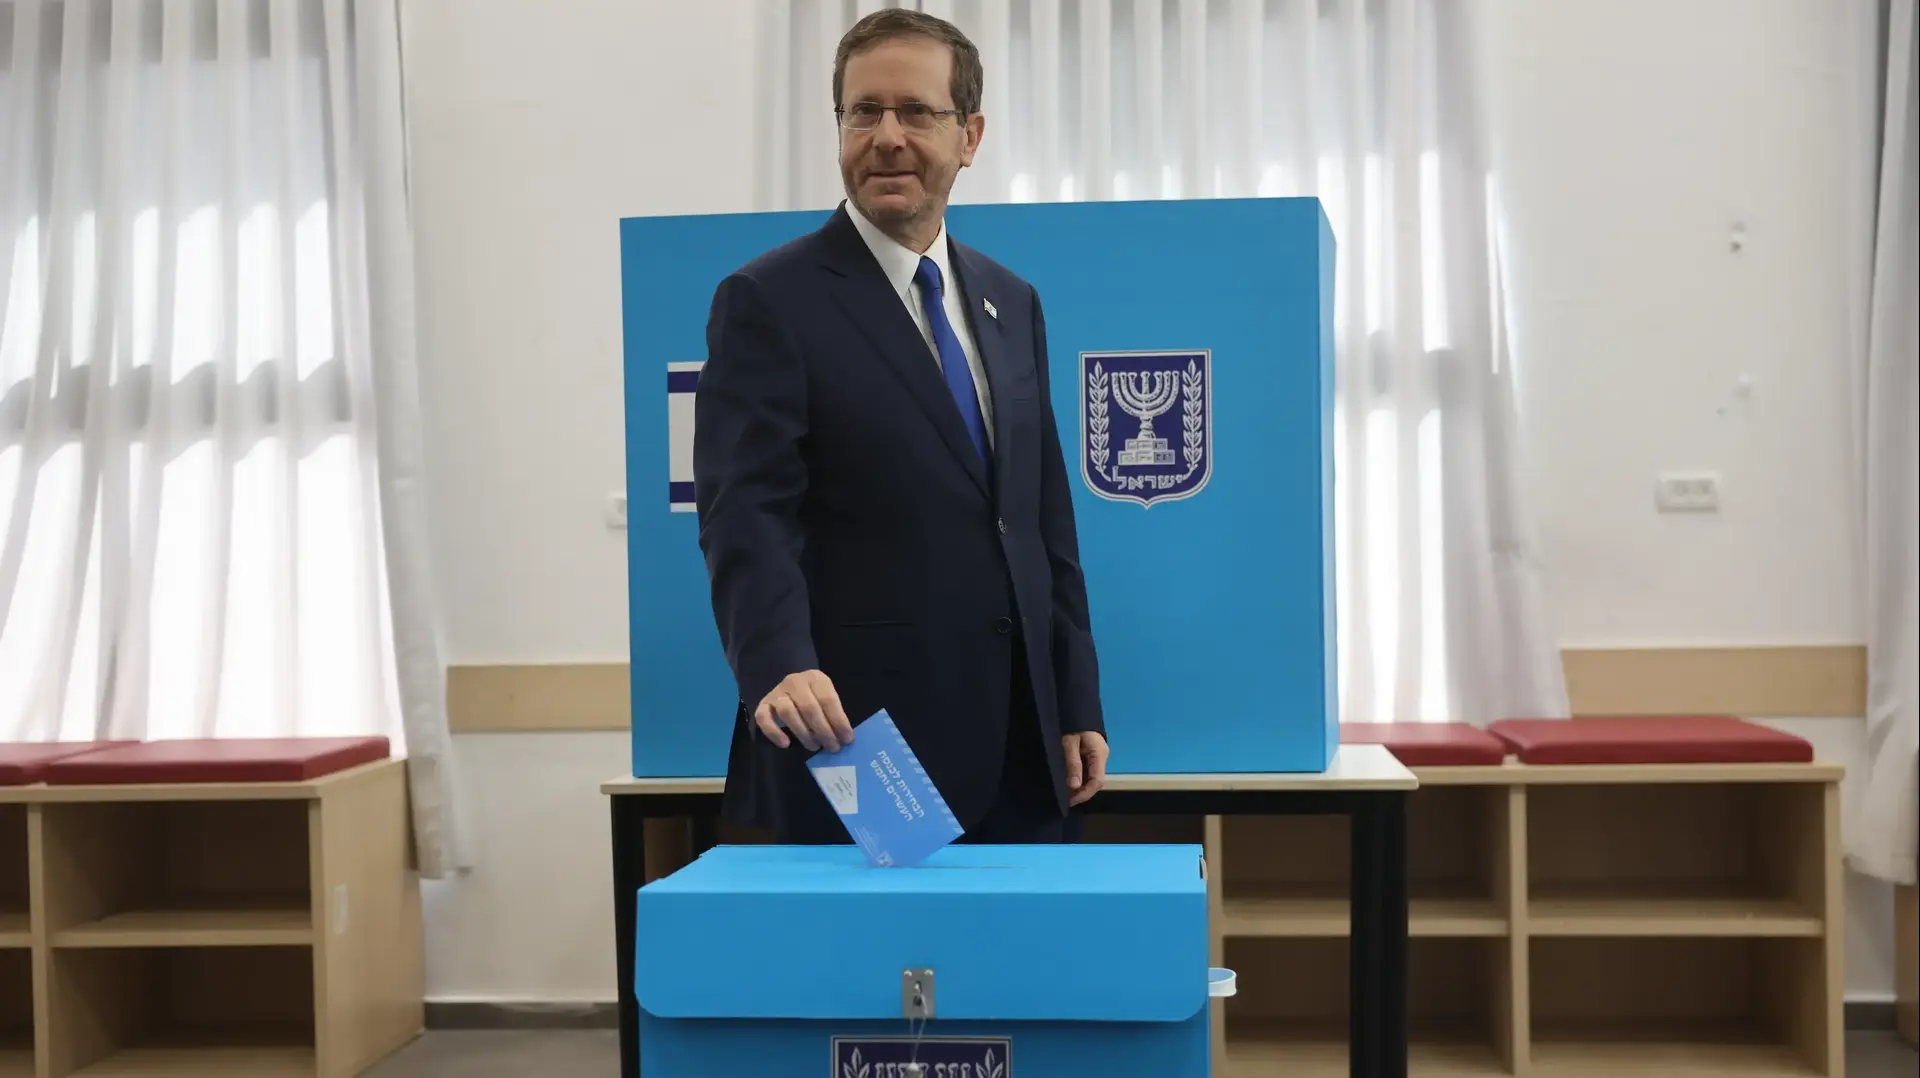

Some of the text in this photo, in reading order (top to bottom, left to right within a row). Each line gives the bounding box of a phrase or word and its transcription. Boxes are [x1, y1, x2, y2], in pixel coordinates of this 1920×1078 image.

[1112, 466, 1184, 490] ישראל
[869, 759, 914, 822] העשרים וחמש
[877, 750, 925, 818] הבחירות לכנסת
